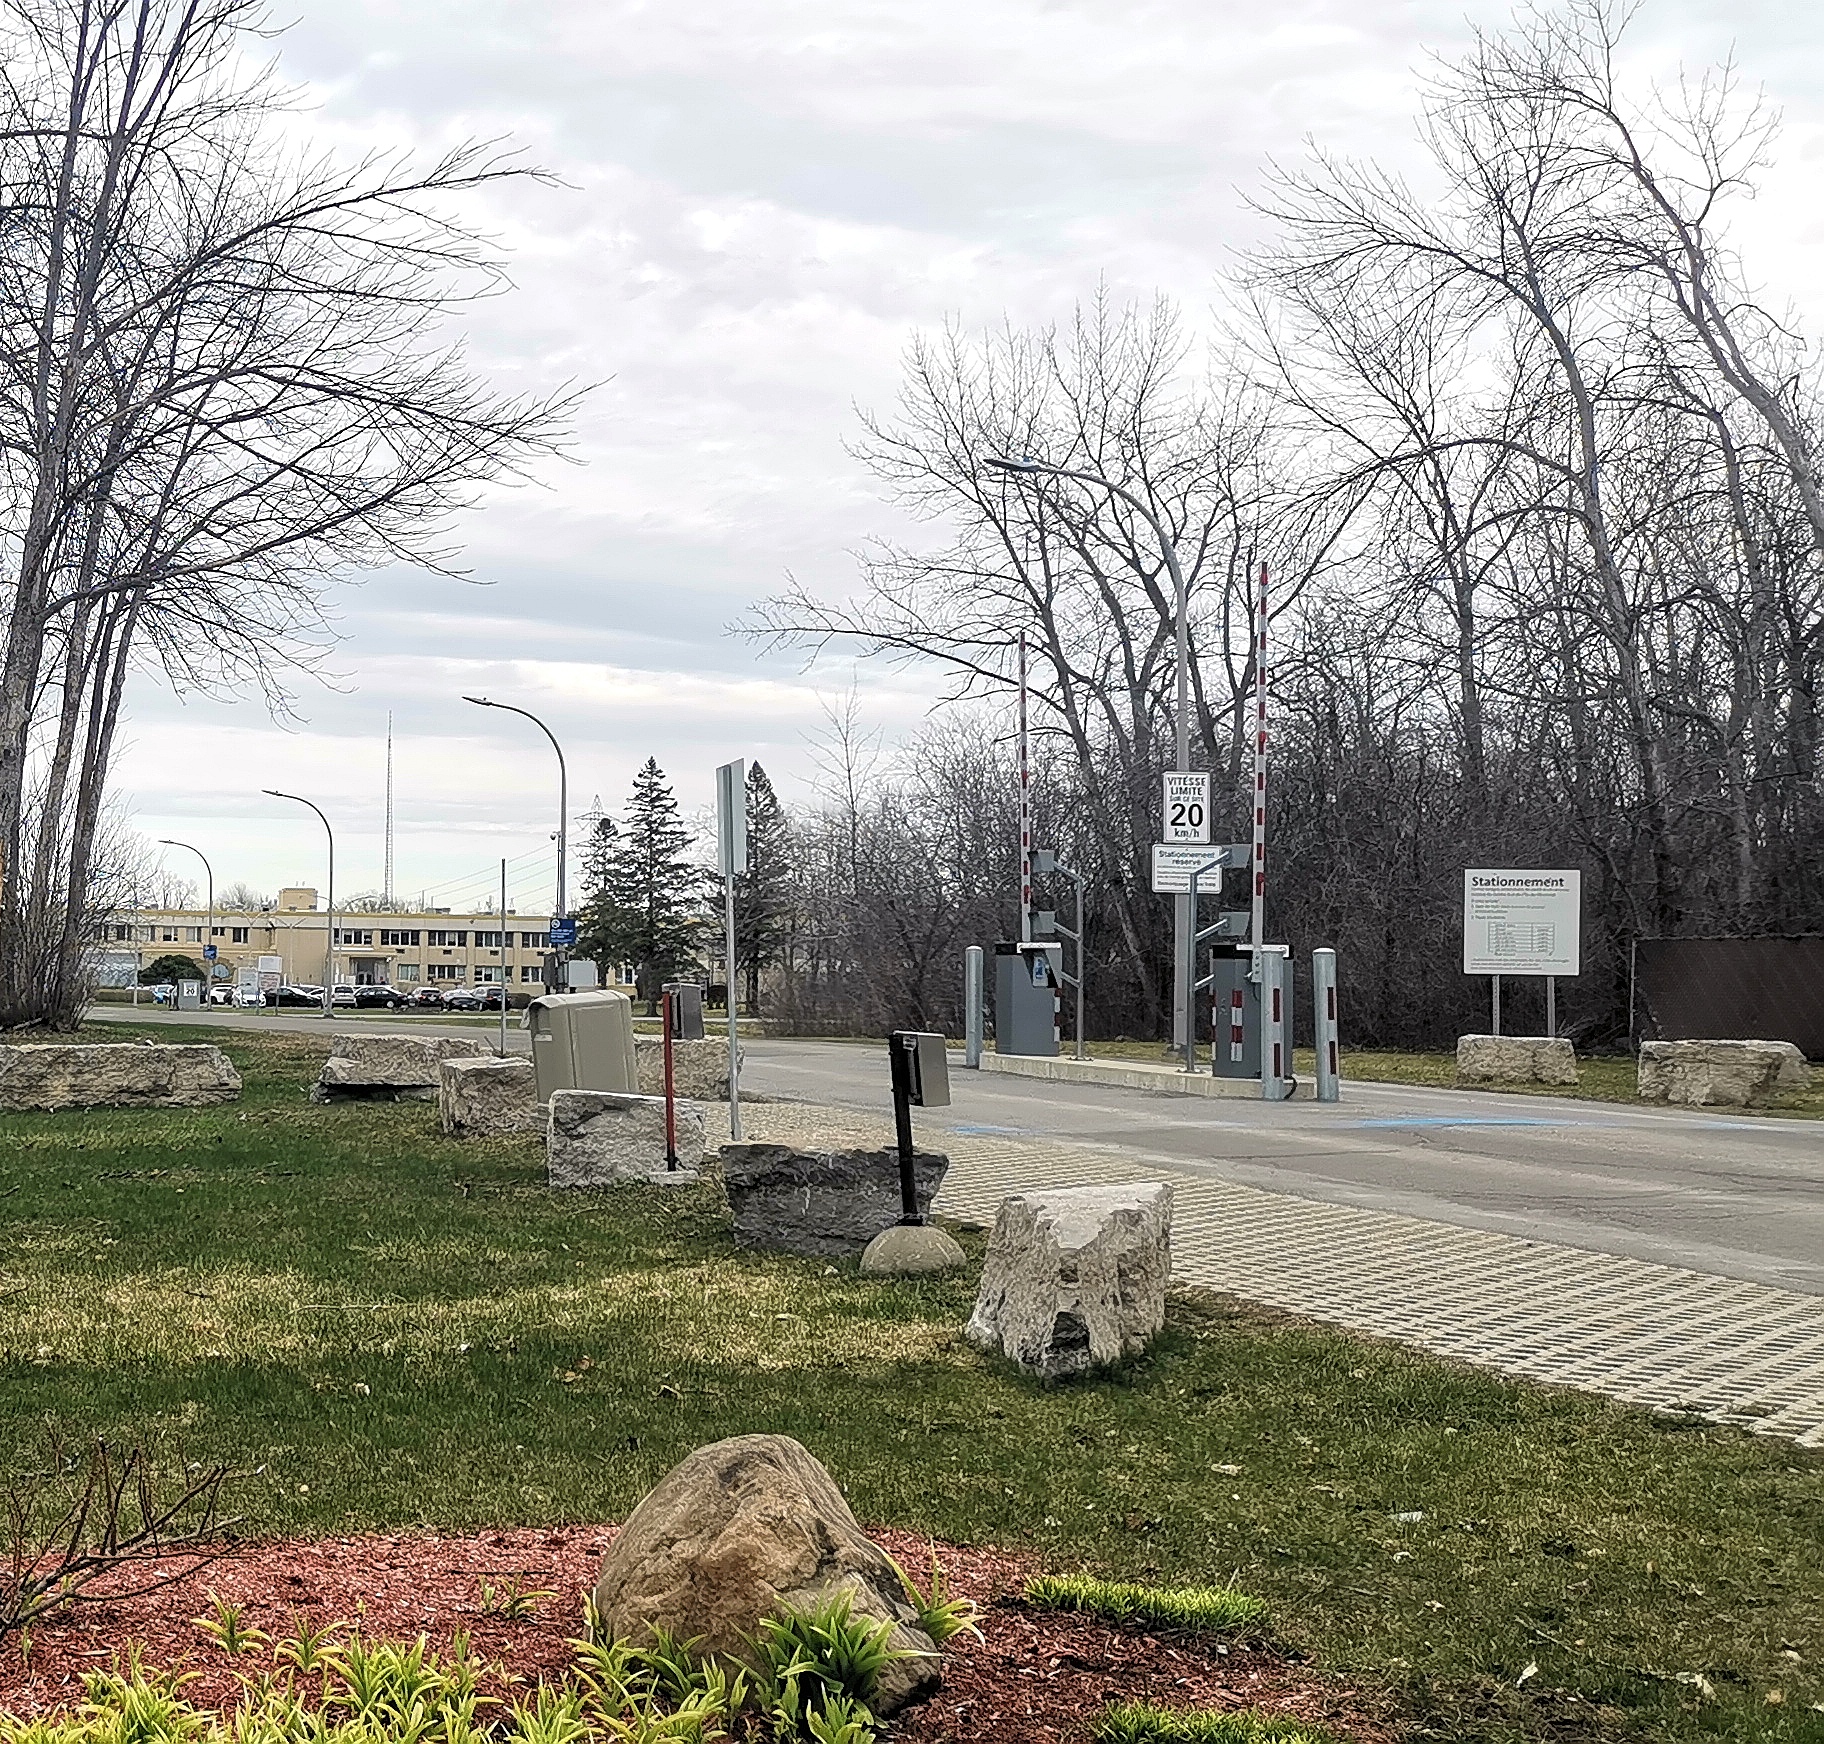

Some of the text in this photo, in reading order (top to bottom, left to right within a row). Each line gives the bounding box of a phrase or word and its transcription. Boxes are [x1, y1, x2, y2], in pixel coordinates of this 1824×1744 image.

[1167, 777, 1206, 786] VITESSE
[1170, 787, 1203, 795] LIMITE
[1170, 803, 1203, 827] 20
[1174, 828, 1200, 838] km/h
[1472, 876, 1565, 888] Stationnement
